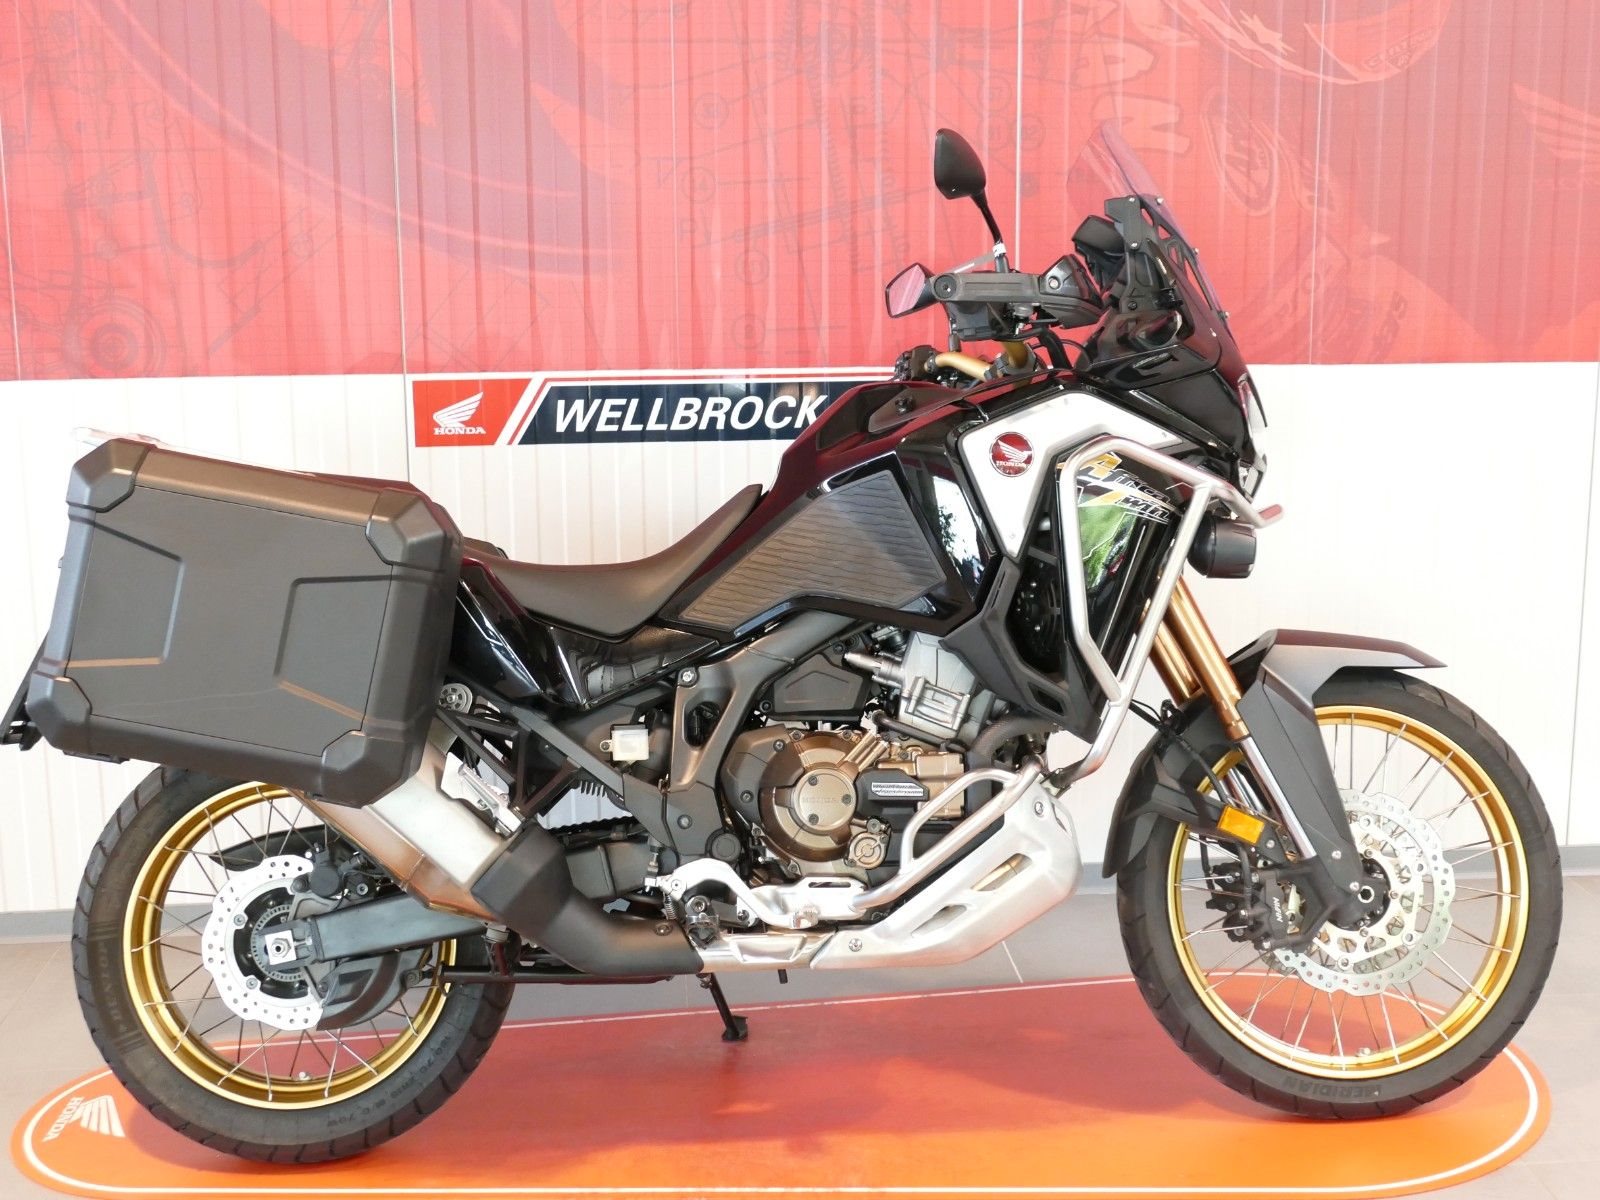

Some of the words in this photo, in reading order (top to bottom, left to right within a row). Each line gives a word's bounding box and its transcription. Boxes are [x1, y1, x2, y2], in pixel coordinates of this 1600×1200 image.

[555, 394, 828, 433] WELLBROCK
[432, 426, 486, 435] HONDA
[995, 460, 1027, 468] HONDA
[1281, 1074, 1383, 1099] MERIDIAN
[41, 1096, 85, 1142] HONDA
